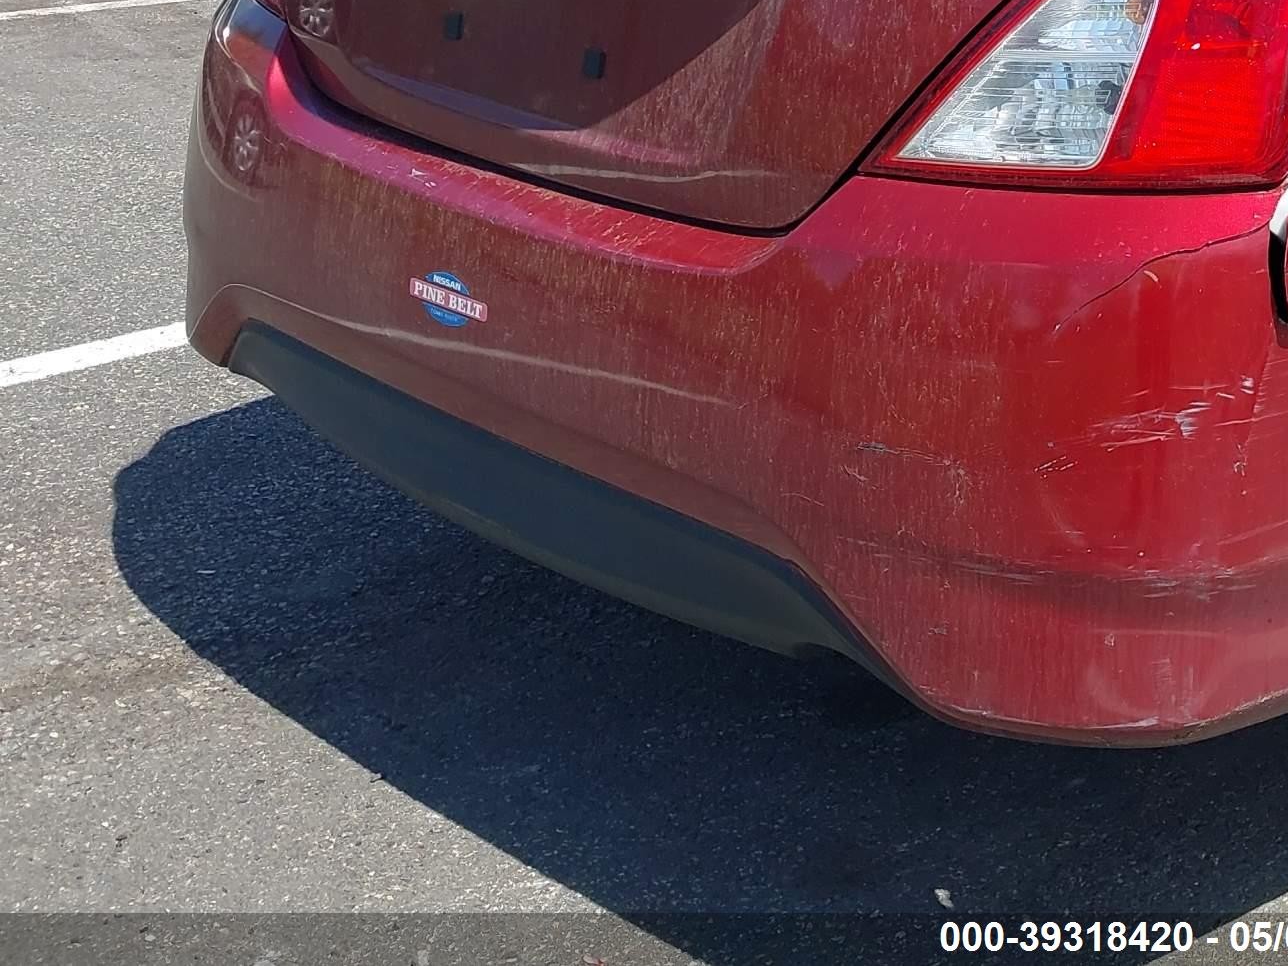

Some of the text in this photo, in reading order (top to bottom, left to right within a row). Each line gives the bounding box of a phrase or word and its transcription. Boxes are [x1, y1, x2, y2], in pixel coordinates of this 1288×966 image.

[433, 274, 461, 291] NISSAN
[413, 281, 445, 306] PINE
[448, 294, 483, 319] BELT
